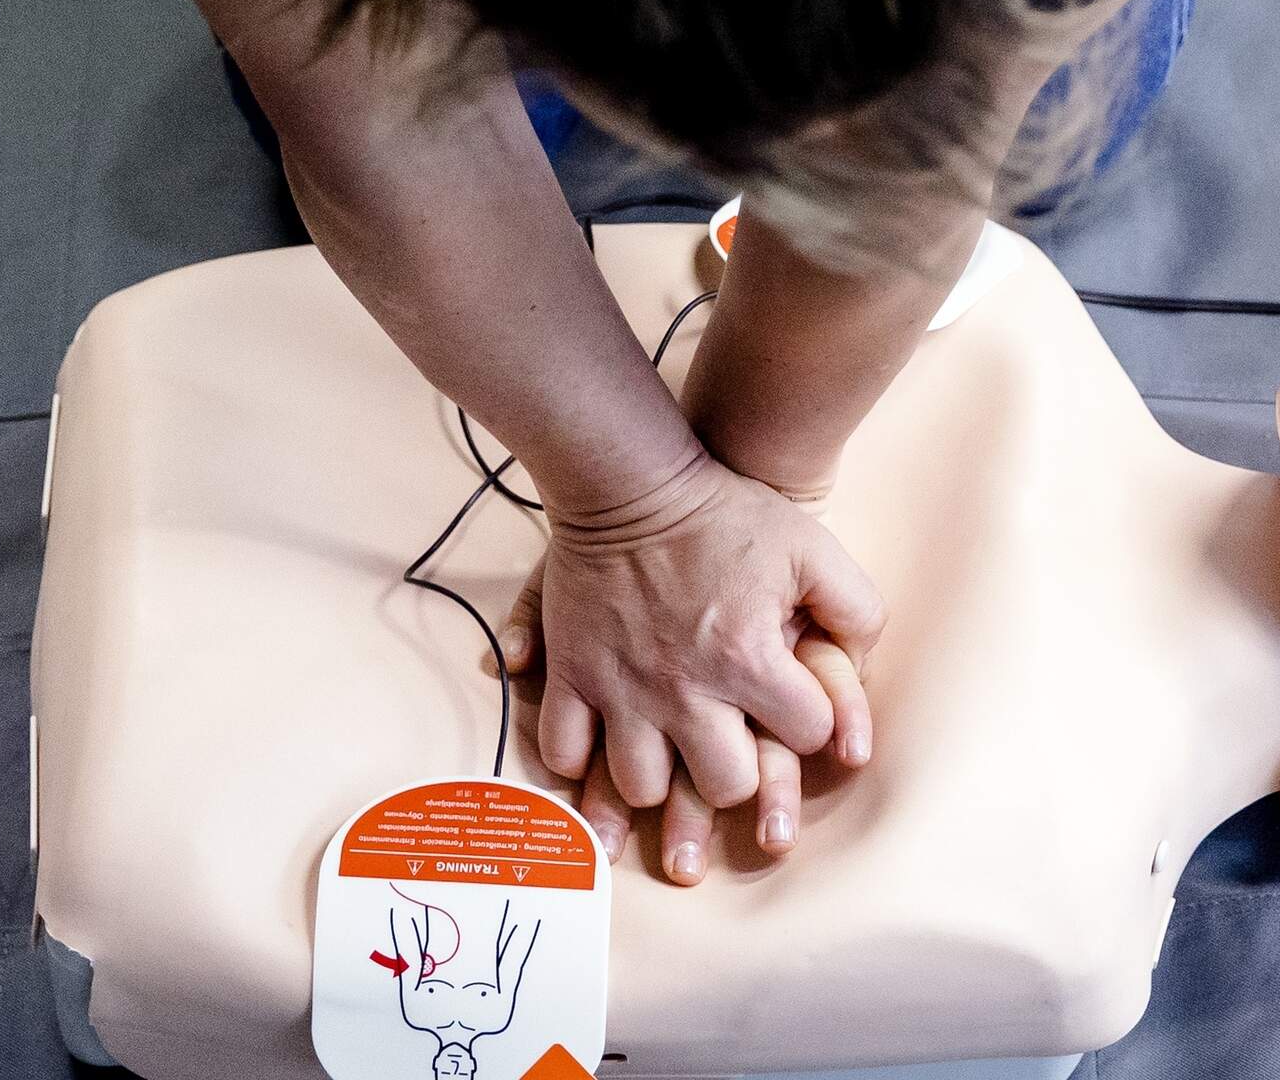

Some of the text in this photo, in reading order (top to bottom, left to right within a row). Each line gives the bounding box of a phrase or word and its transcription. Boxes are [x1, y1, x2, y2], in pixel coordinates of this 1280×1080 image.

[488, 802, 530, 812] Utbildning
[530, 818, 569, 829] Szkolenie
[465, 827, 526, 839] Addestramento
[531, 831, 572, 842] Formation
[358, 835, 416, 846] Entrenamiento
[524, 842, 562, 854] Schulung
[436, 861, 500, 875] TRAINING
